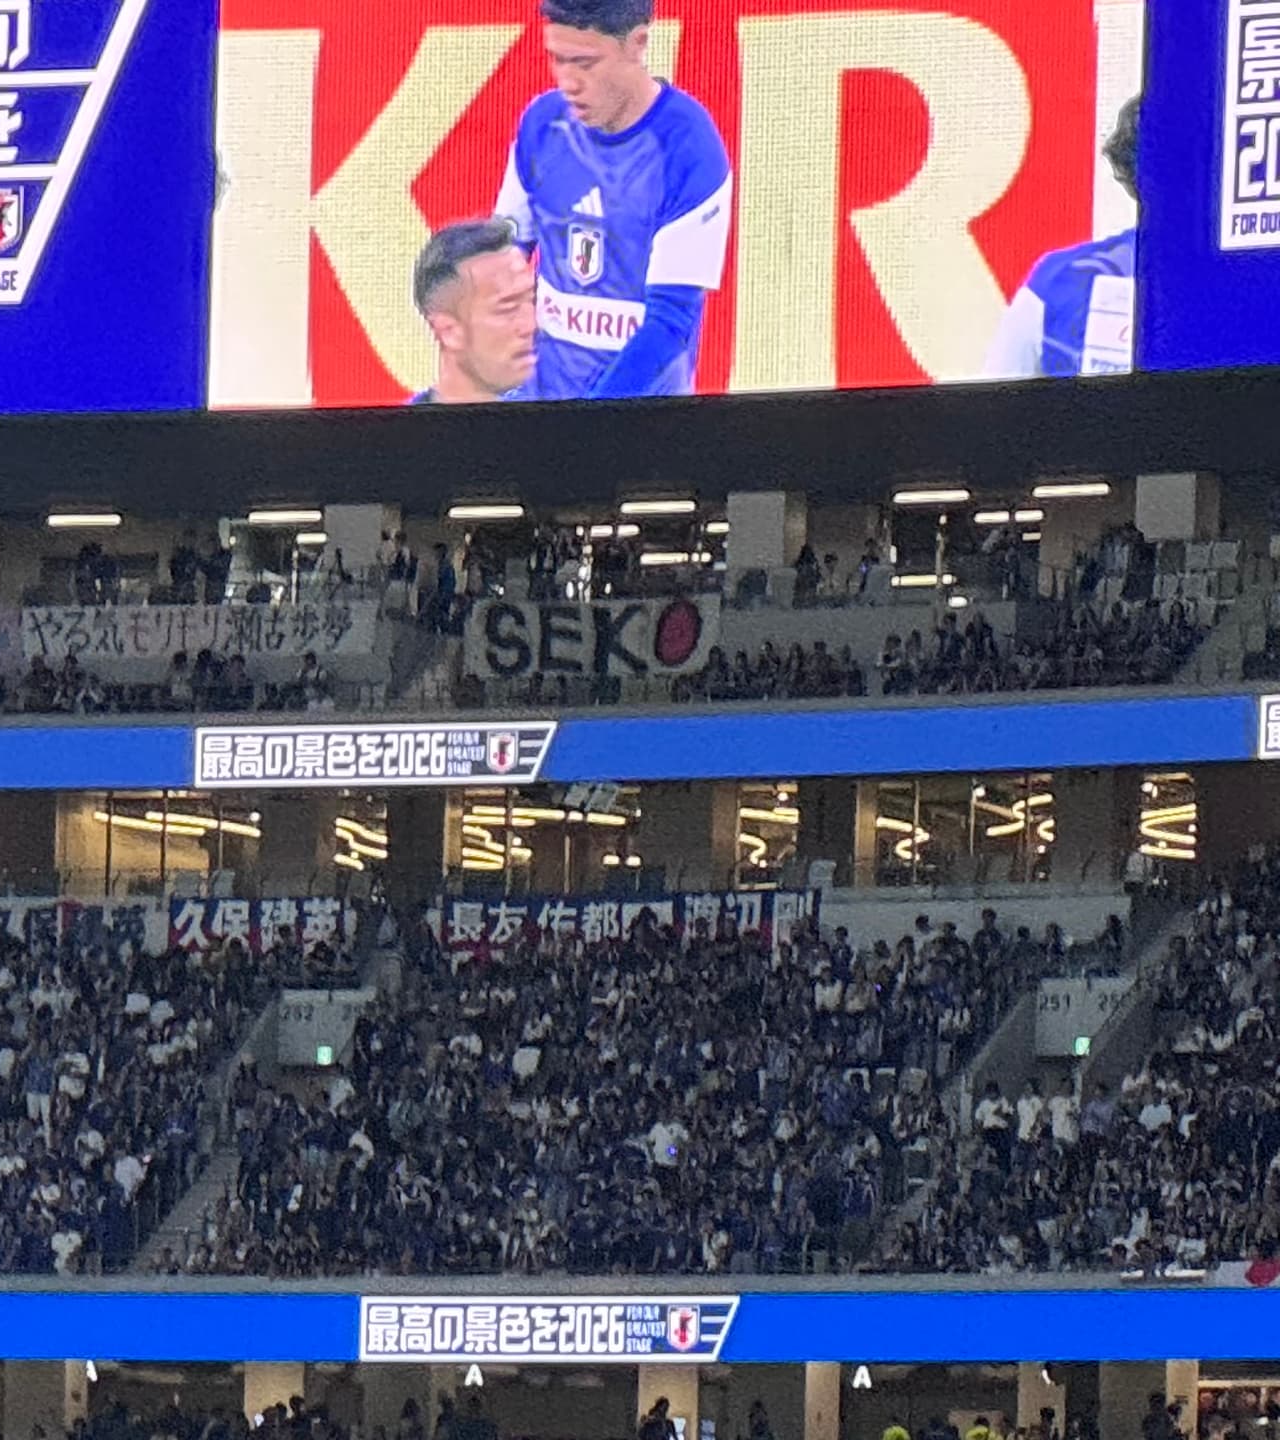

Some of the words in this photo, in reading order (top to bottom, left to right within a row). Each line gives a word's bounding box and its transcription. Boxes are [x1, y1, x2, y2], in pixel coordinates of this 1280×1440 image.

[1231, 213, 1257, 236] FOR
[485, 600, 703, 676] SEKO
[203, 733, 445, 778] 最高の景色を2026
[367, 1305, 625, 1353] 最高の景色を2026
